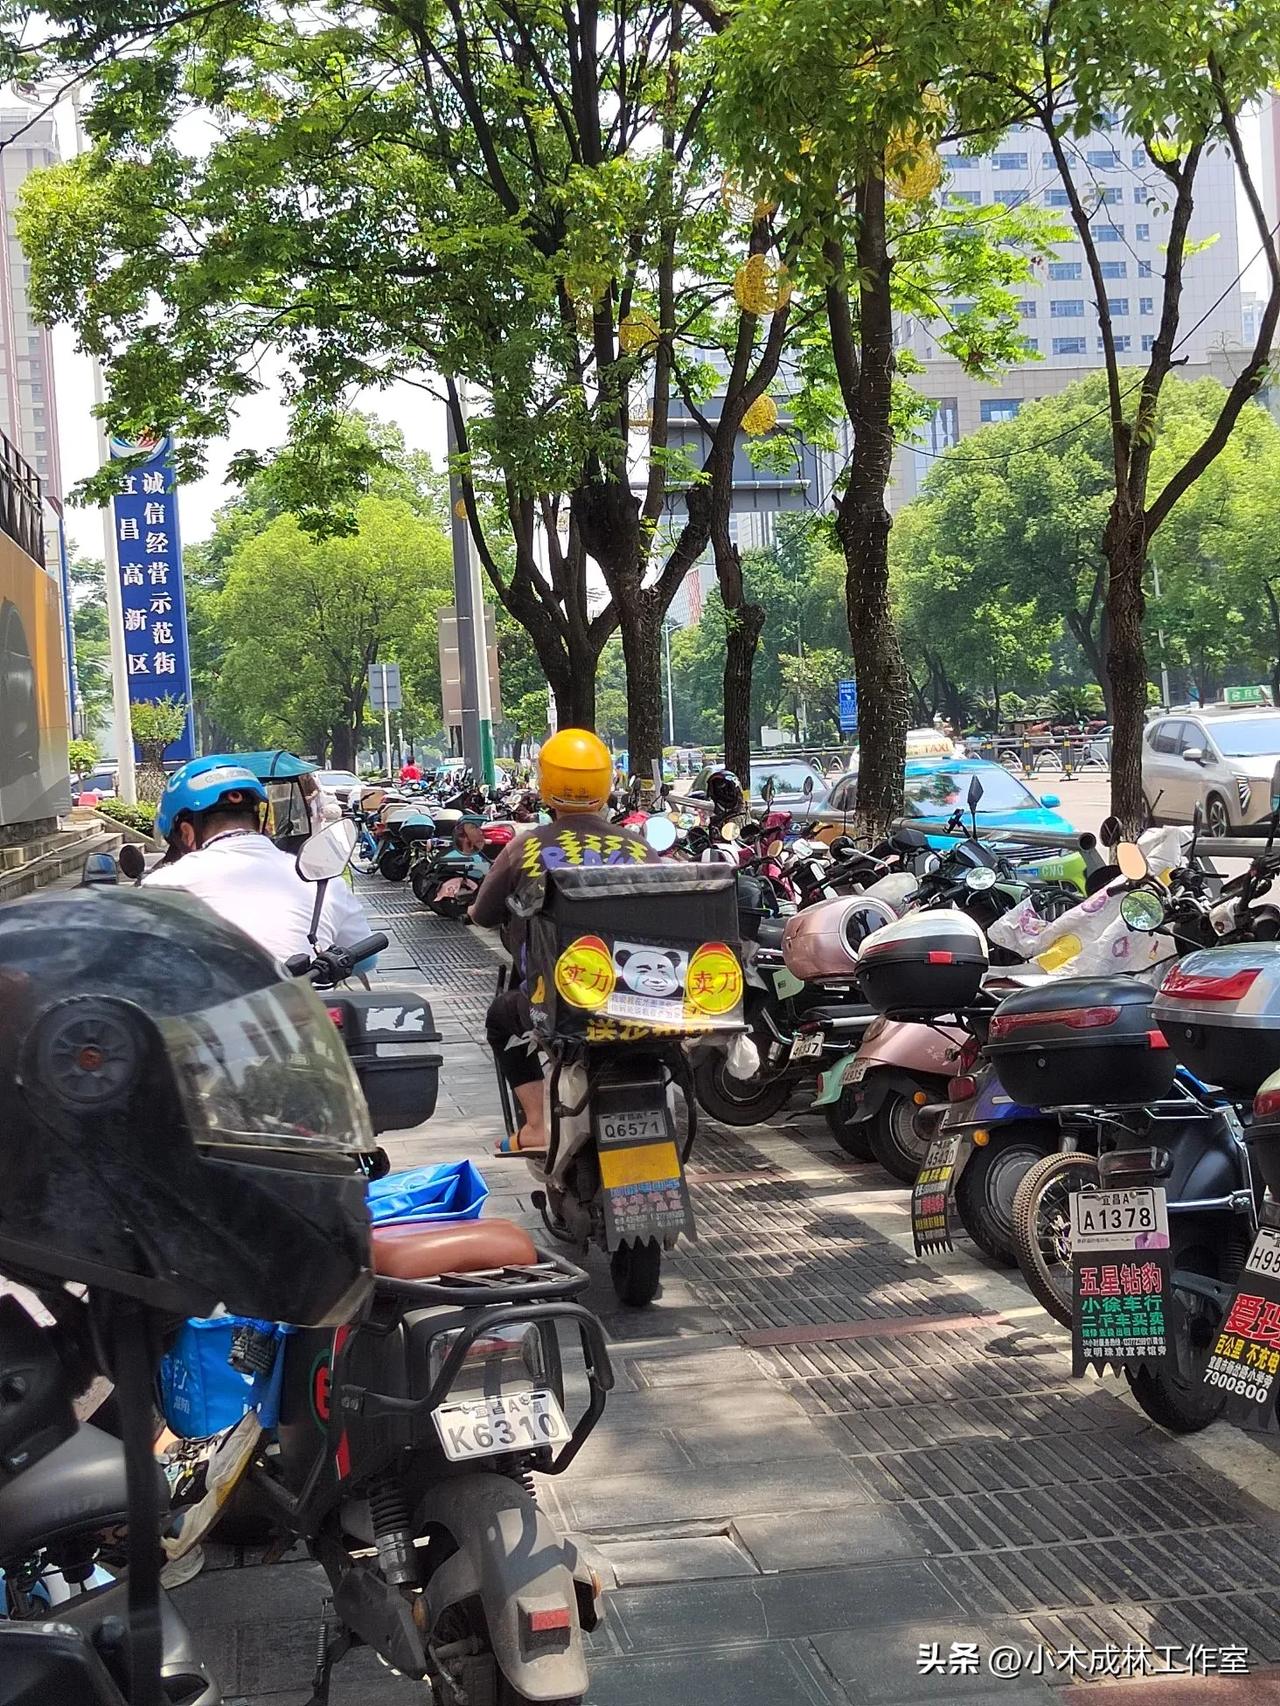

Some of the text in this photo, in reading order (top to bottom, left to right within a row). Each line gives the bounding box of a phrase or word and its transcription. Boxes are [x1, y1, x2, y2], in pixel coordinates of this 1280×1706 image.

[117, 475, 150, 675] 宜昌高新区
[142, 472, 176, 675] 诚信经营示范街
[924, 743, 949, 753] TAXI
[1042, 864, 1064, 877] CNG
[562, 965, 610, 993] 实力
[605, 1121, 660, 1138] Q6571
[1101, 1193, 1130, 1206] 宜昌A
[1084, 1207, 1151, 1231] A1378
[1080, 1262, 1163, 1295] 五星钻豹
[1082, 1295, 1163, 1313] 小徐车行
[1214, 1334, 1280, 1375] 百公里 不充电
[1203, 1369, 1268, 1403] 7900800
[448, 1413, 559, 1453] K6310
